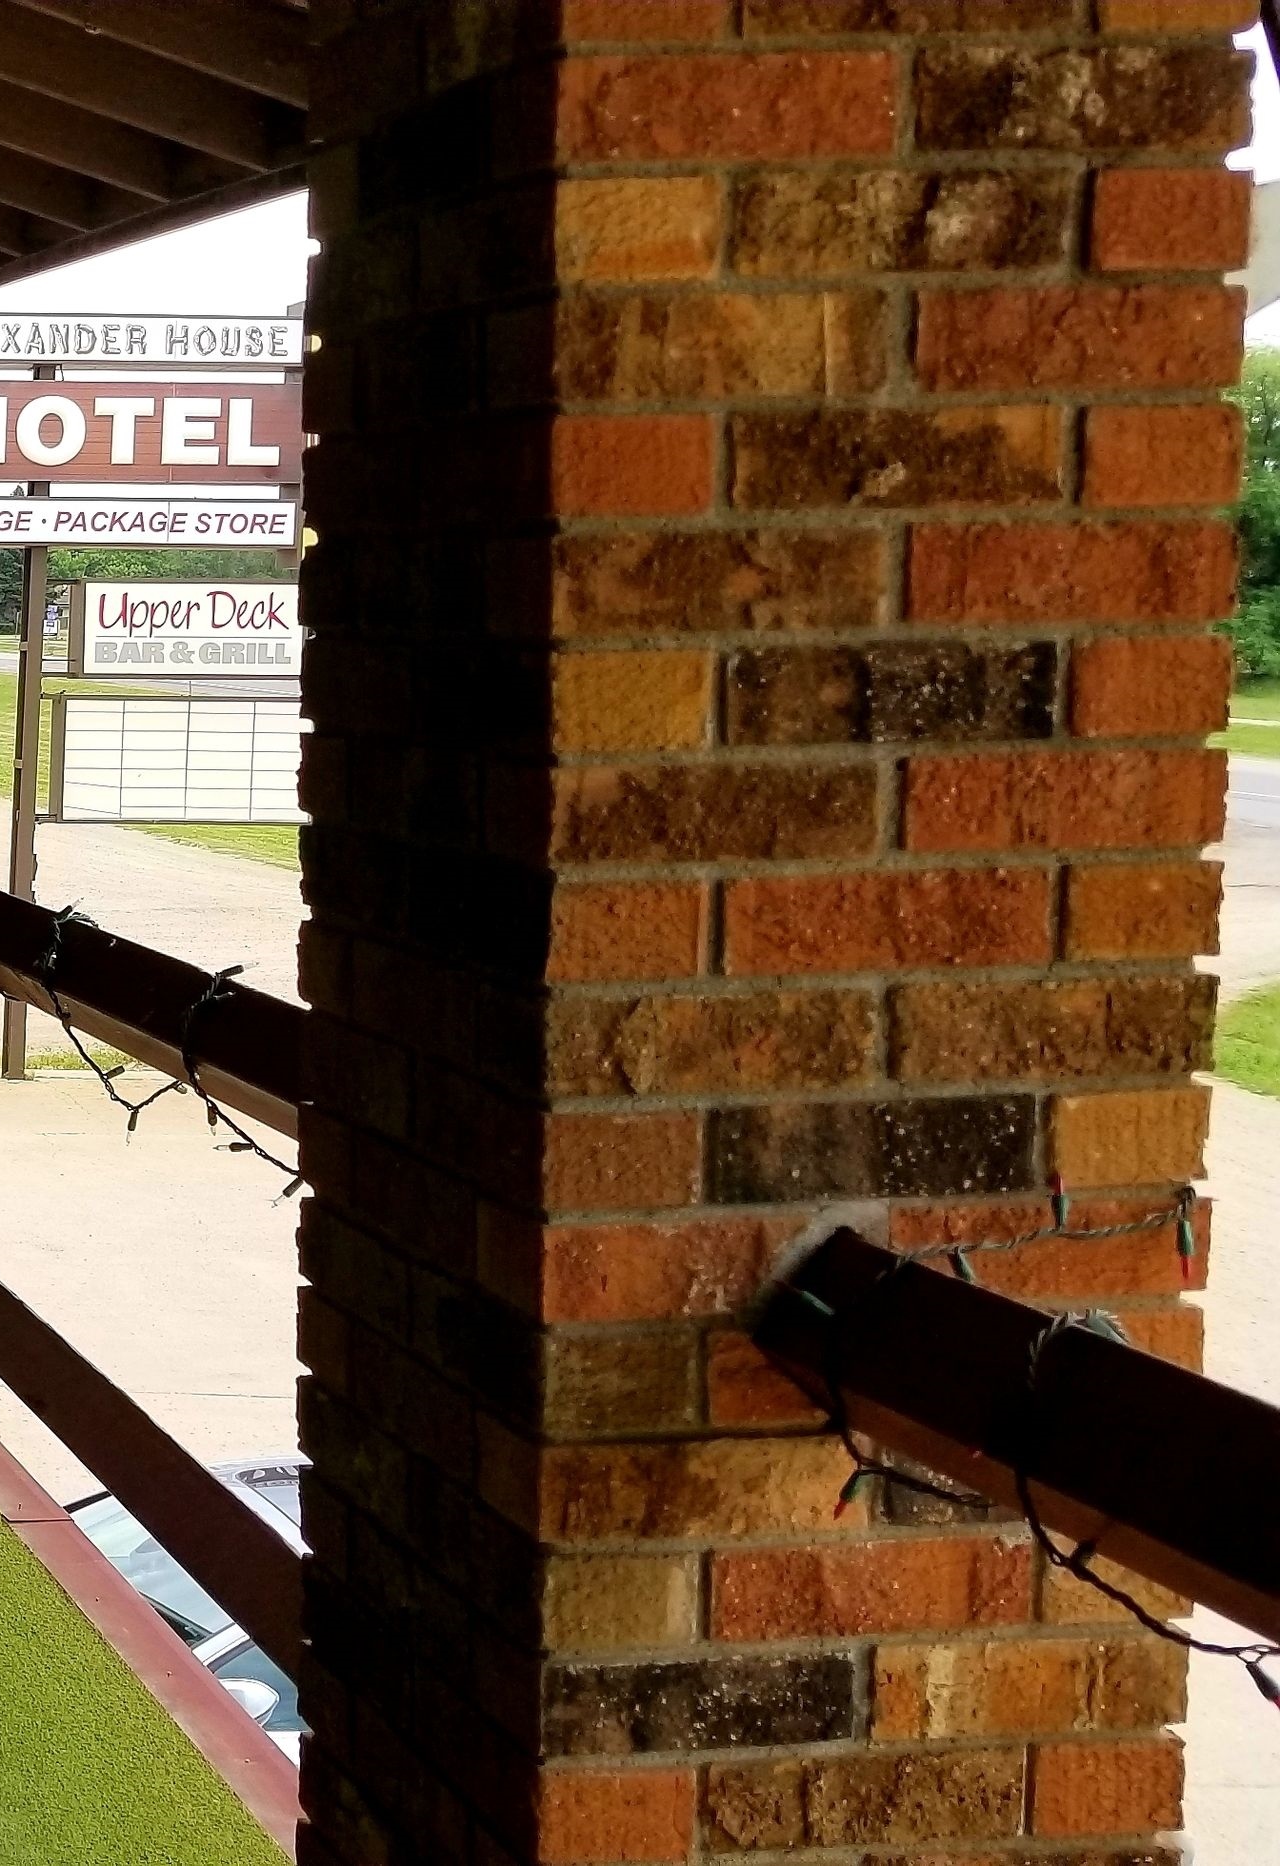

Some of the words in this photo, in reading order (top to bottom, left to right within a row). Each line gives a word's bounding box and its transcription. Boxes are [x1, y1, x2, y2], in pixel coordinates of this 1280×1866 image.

[165, 324, 289, 357] HOUSE
[53, 510, 188, 534] PACKAGE
[194, 511, 288, 535] STORE
[98, 592, 200, 637] Upper
[206, 590, 289, 630] Deck
[94, 641, 164, 664] BAR
[169, 641, 195, 664] &
[198, 642, 291, 664] GRILL
